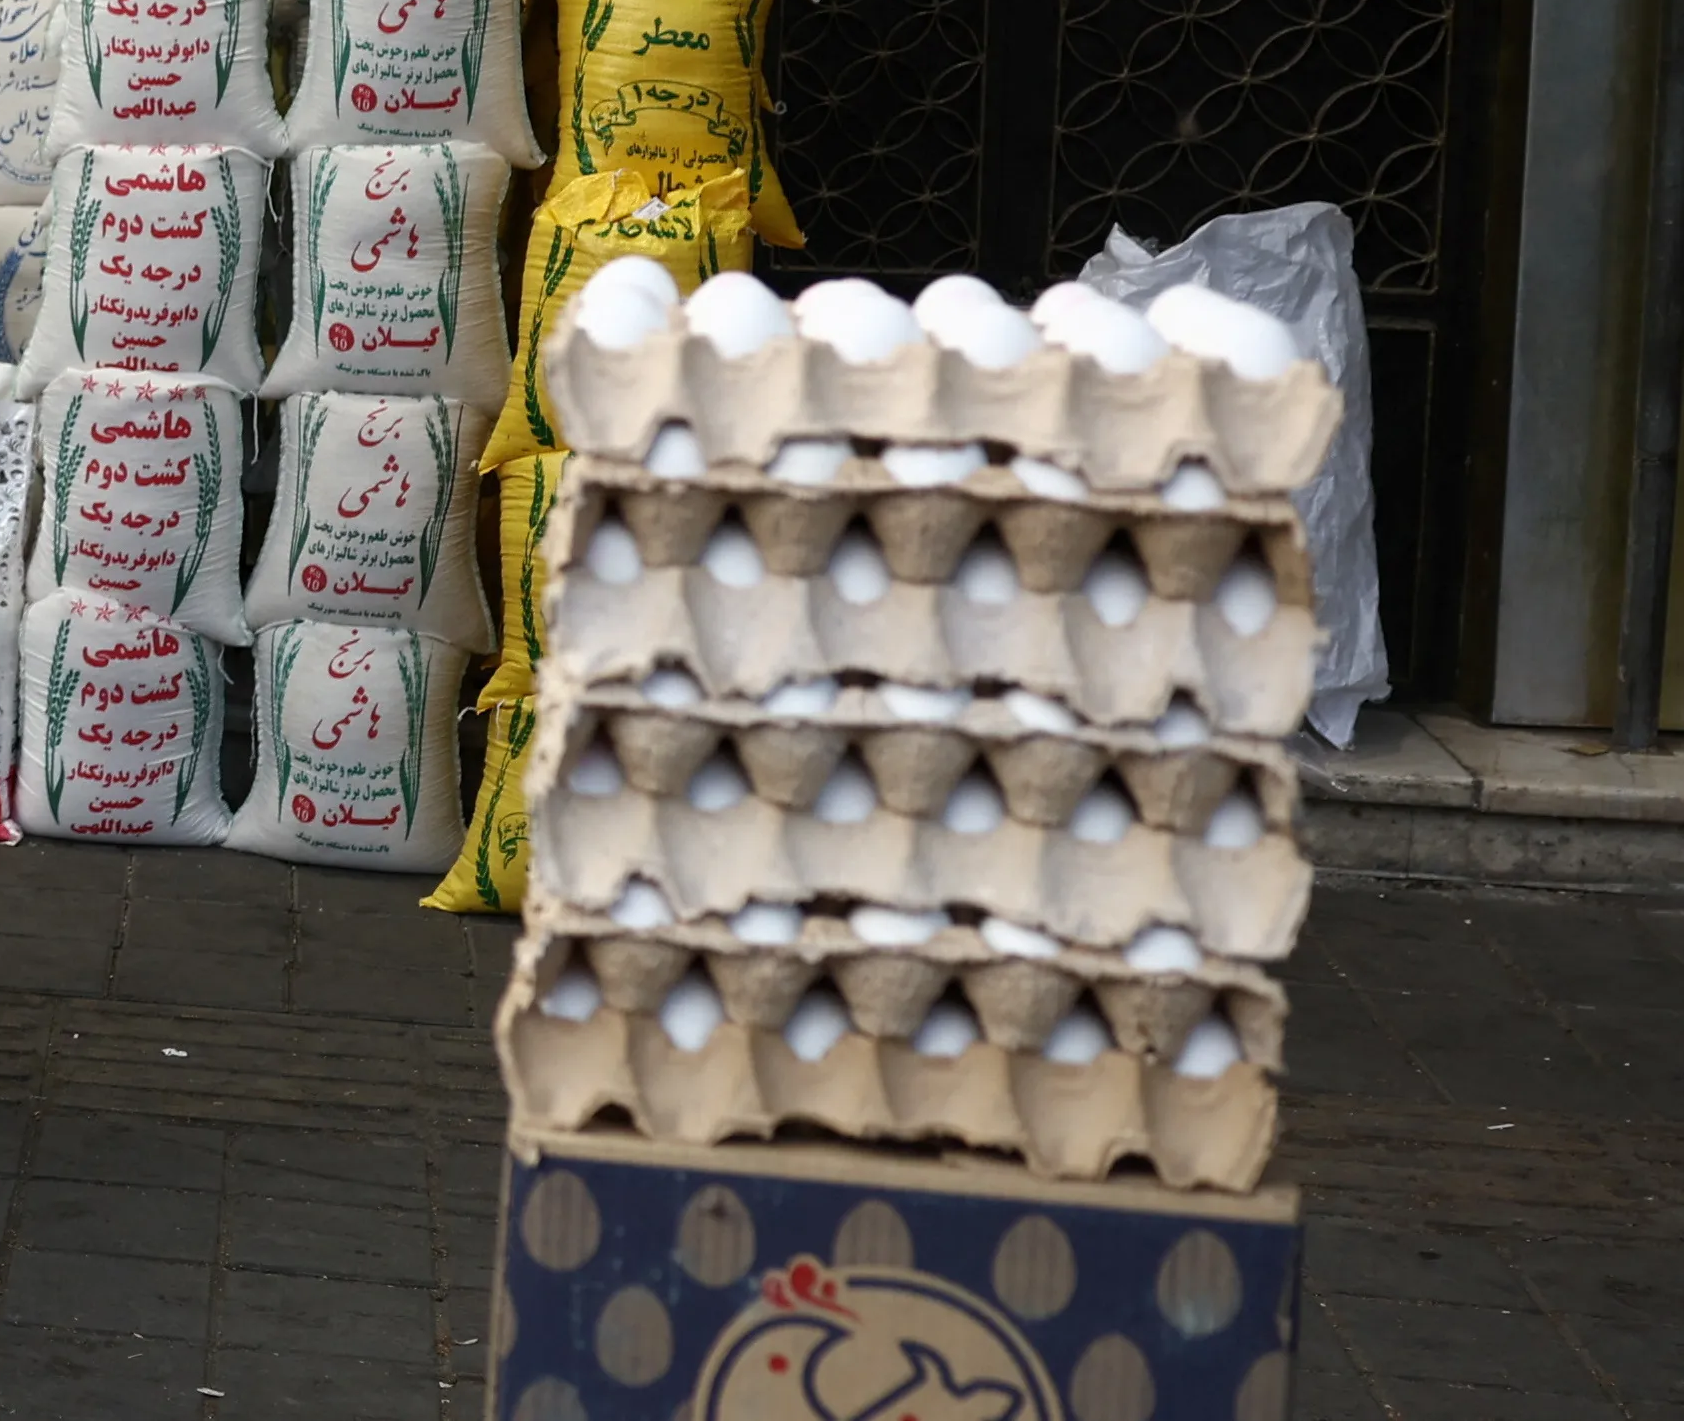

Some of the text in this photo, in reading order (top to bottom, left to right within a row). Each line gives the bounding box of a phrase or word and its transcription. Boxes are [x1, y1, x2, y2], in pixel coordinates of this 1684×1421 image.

[355, 97, 370, 111] 10
[358, 399, 403, 447] برنج
[338, 455, 410, 518] هاشمی
[307, 578, 320, 591] 10
[83, 628, 179, 667] هاشمی
[81, 672, 183, 711] کشت دوم
[78, 723, 178, 750] درجه یک
[89, 794, 144, 813] حسین
[71, 818, 154, 837] عبداللهی
